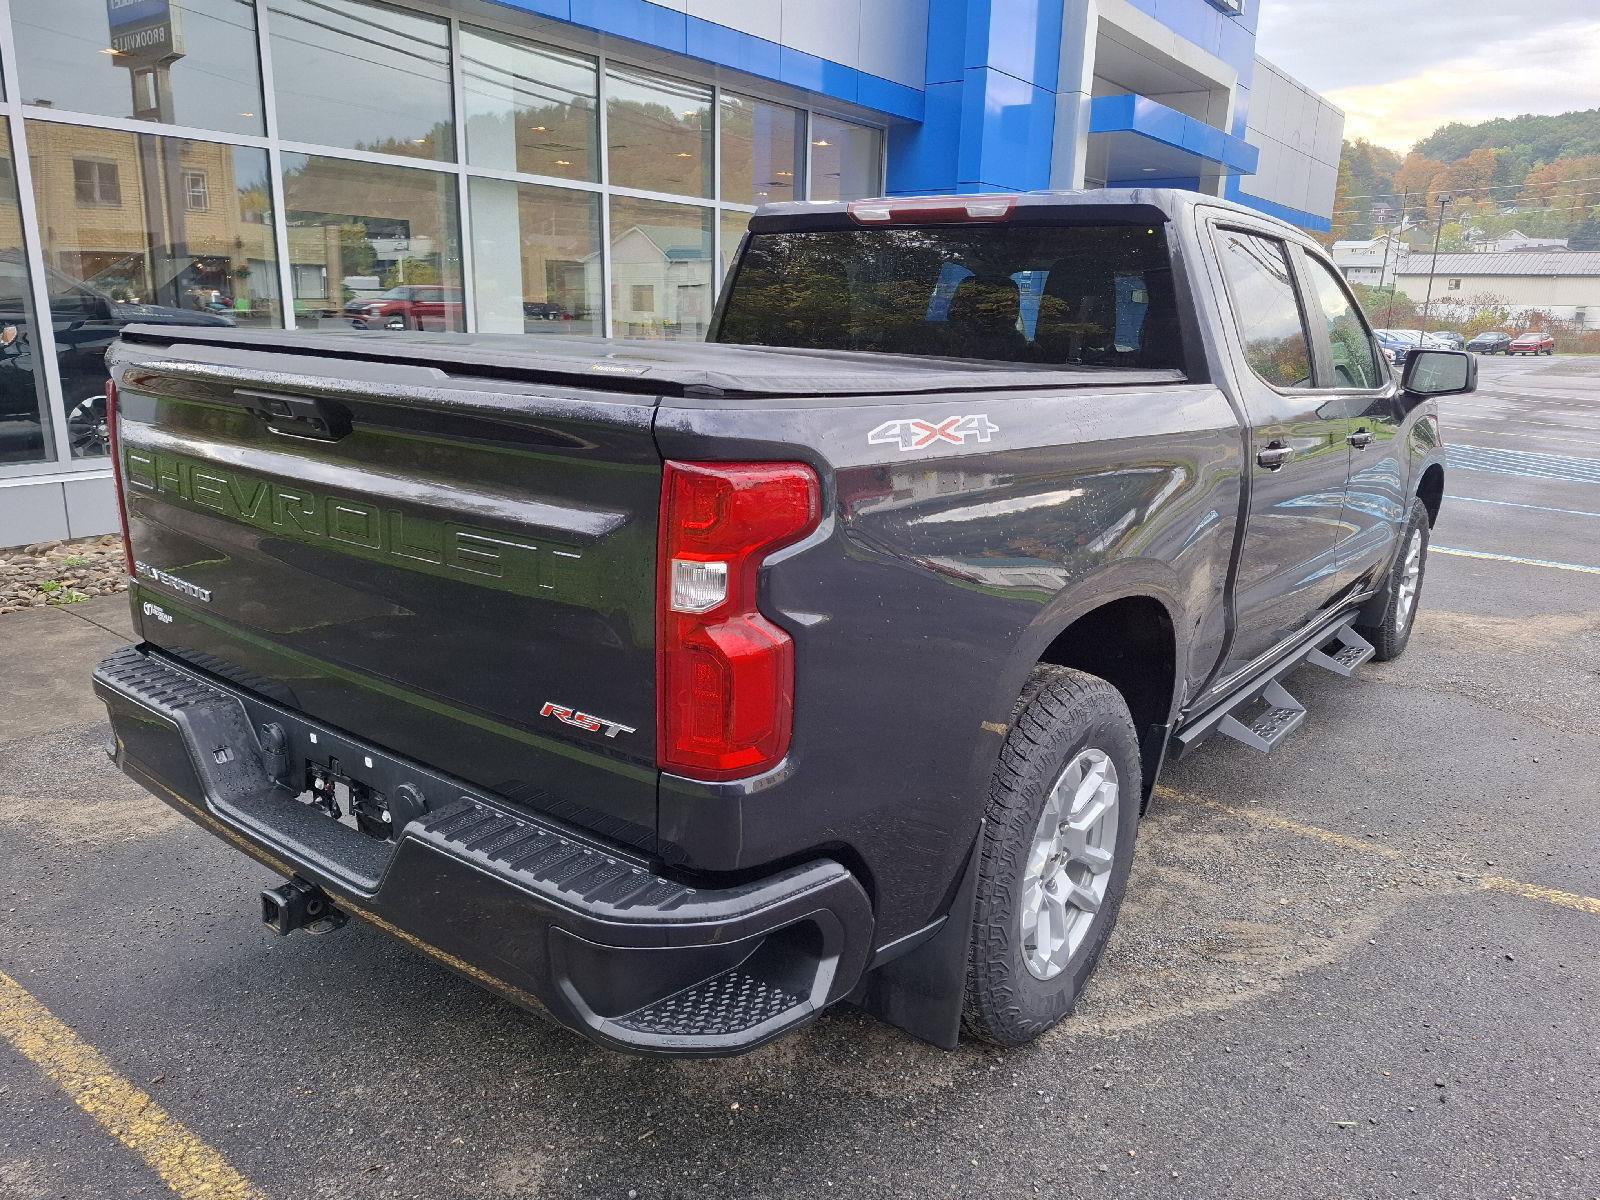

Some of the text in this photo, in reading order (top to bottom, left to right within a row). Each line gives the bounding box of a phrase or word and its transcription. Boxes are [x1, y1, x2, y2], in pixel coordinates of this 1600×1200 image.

[126, 448, 583, 589] CHEVROLET
[135, 560, 212, 602] SILVERADO
[540, 702, 637, 738] RST
